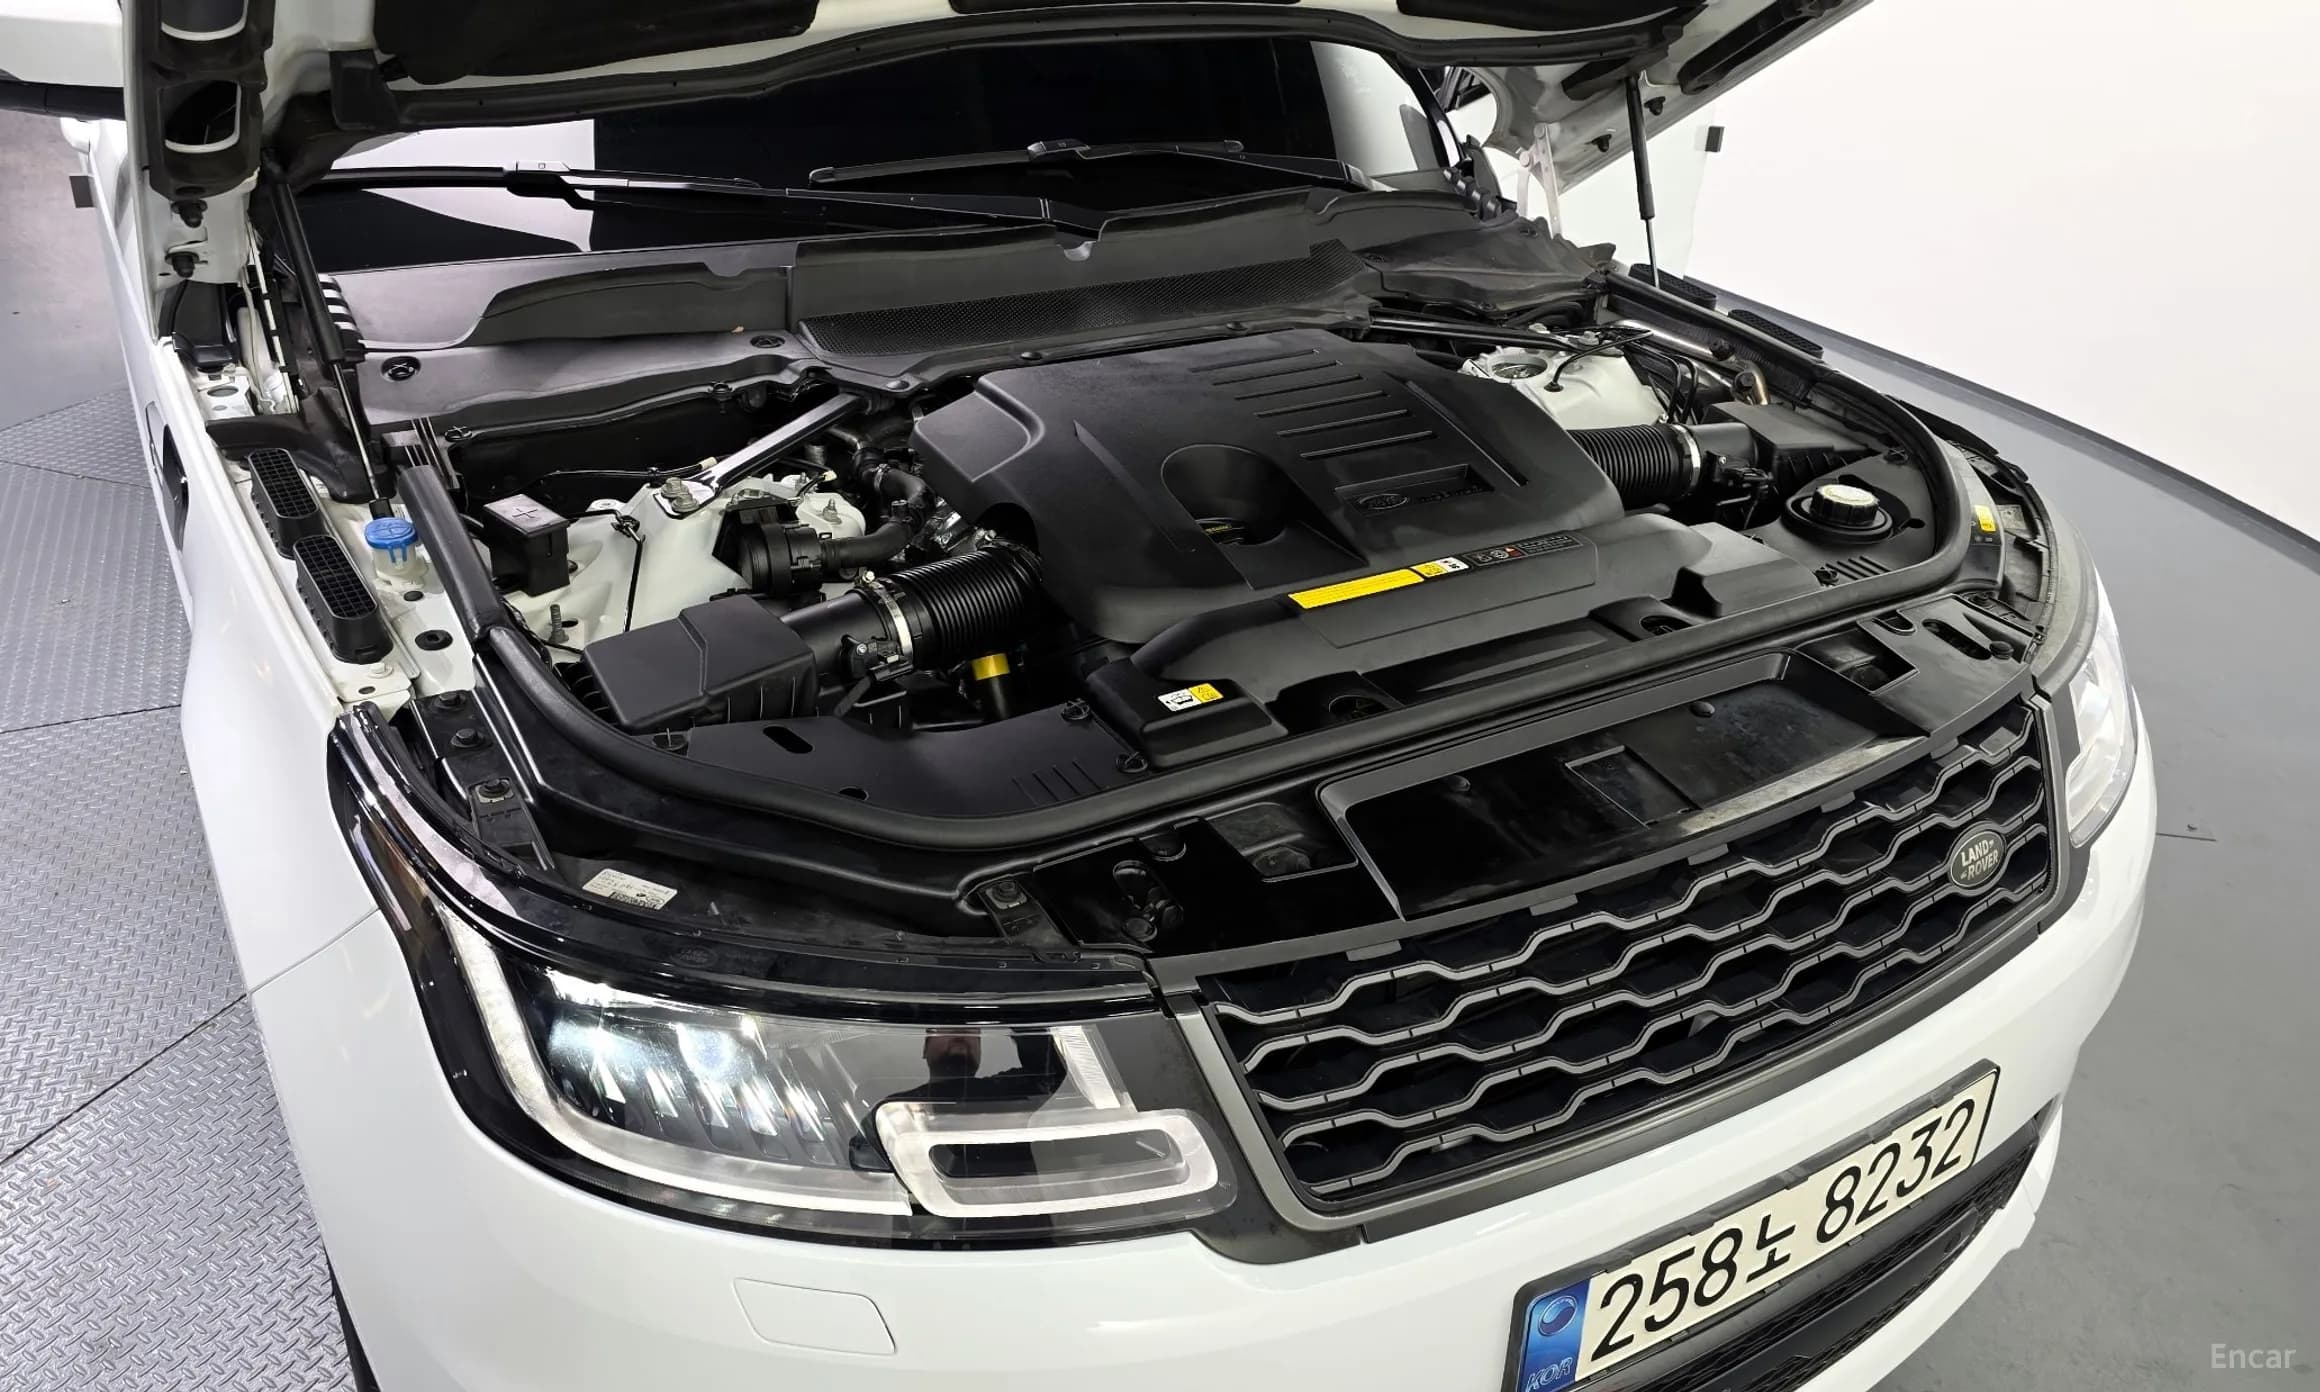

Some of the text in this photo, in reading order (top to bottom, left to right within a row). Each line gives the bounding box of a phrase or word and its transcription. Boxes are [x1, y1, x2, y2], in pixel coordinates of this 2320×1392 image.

[1960, 839, 1990, 867] LAND
[1966, 848, 2000, 881] ROVER
[1590, 1098, 1976, 1363] 258노 8232
[1524, 1356, 1574, 1392] KOR
